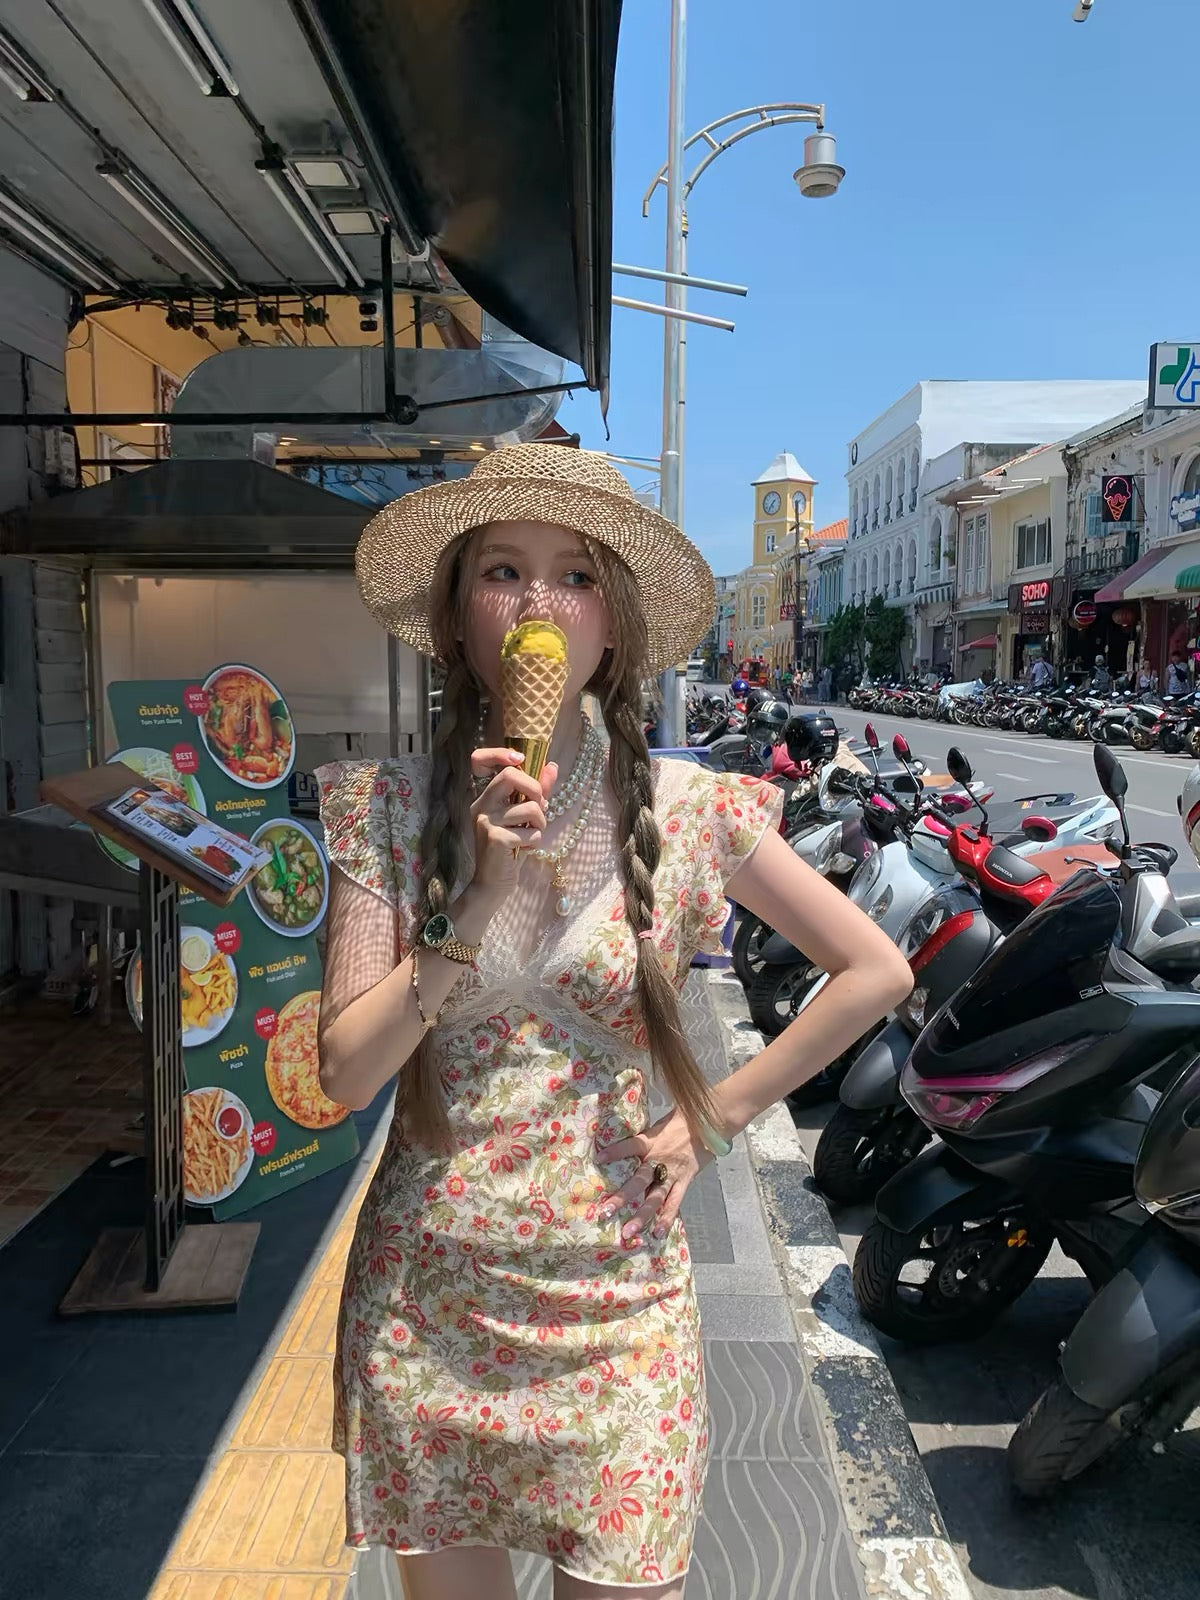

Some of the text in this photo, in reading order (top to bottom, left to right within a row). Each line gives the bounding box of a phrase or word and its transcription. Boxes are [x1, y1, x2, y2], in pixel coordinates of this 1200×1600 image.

[1022, 583, 1047, 600] SOHO
[175, 752, 193, 761] BEST
[991, 863, 1013, 878] HONDA
[217, 929, 237, 941] MUST
[256, 1014, 275, 1026] MUST
[230, 1061, 244, 1070] Pizza
[253, 1128, 272, 1142] MUST
